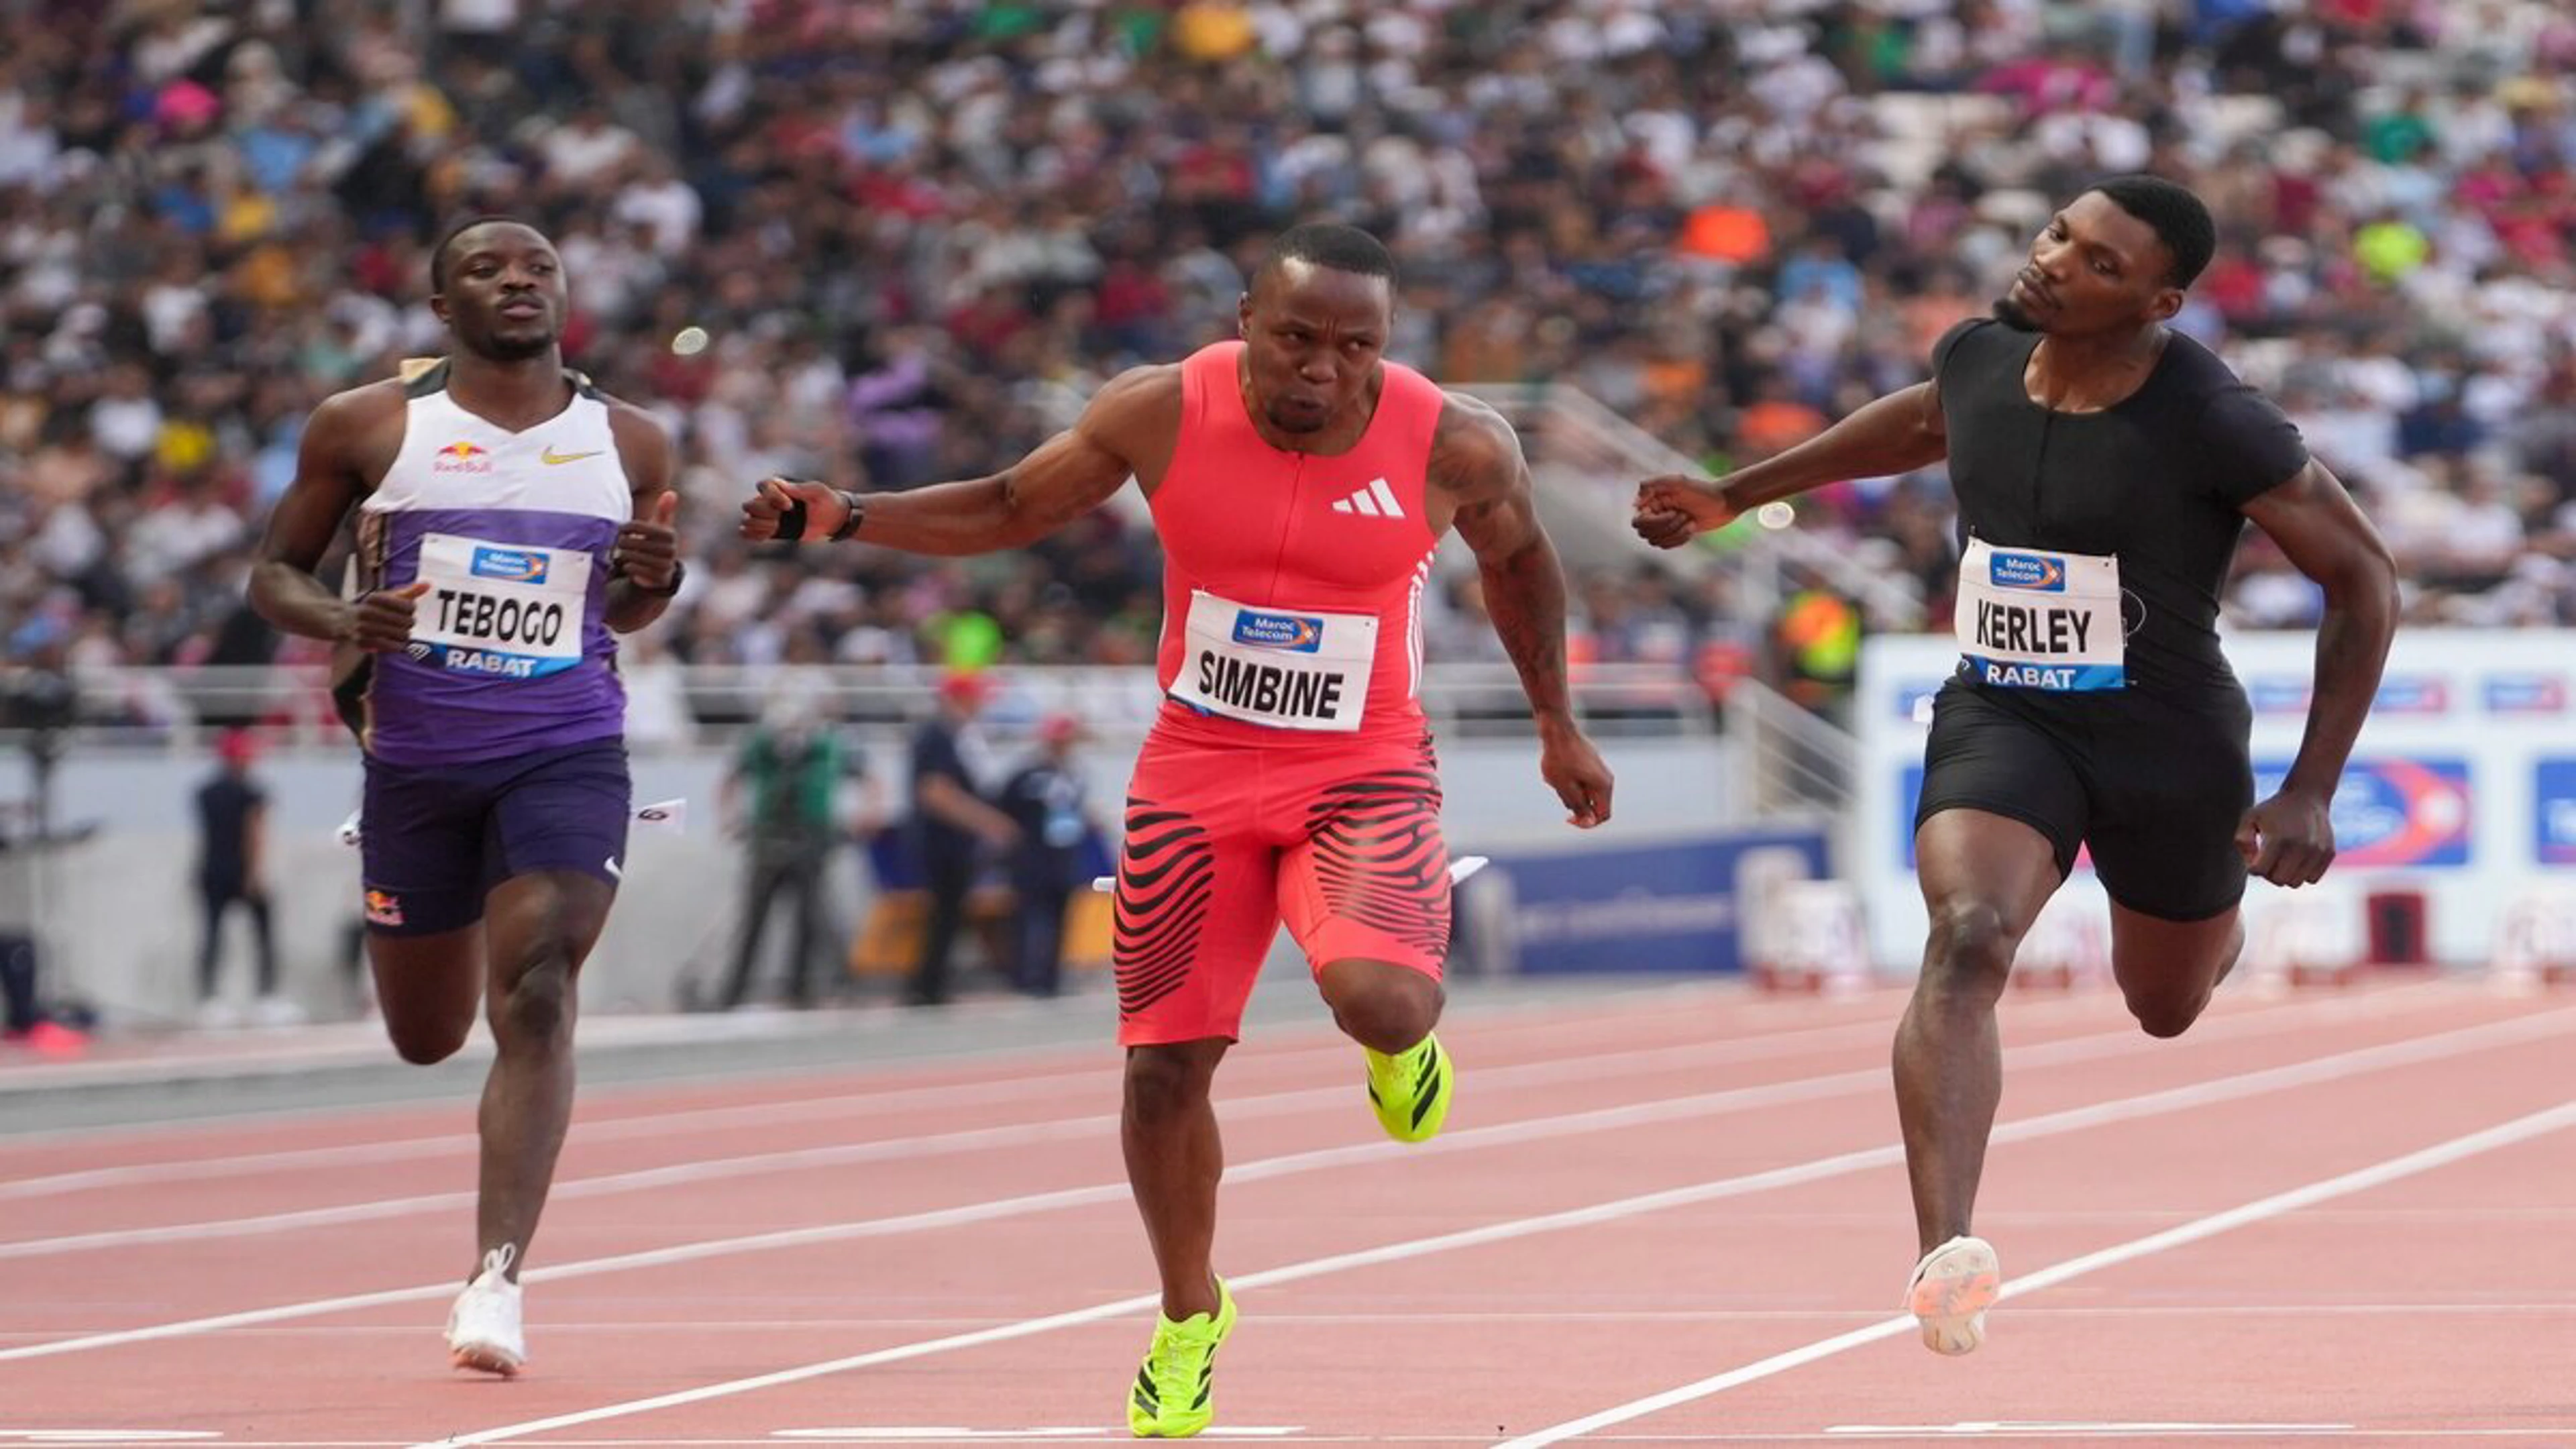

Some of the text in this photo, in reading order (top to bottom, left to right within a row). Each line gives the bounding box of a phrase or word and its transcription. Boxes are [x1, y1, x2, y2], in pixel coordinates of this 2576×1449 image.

[1995, 566, 2041, 580] Telecom
[2006, 557, 2041, 571] Maroc
[437, 589, 562, 646] TEBOGO
[1254, 616, 1295, 631] Maroc
[1976, 598, 2092, 653] KERLEY
[1242, 624, 1294, 641] Telecom
[446, 648, 537, 678] RABAT
[1986, 663, 2076, 690] RABAT
[1199, 649, 1344, 720] SIMBINE
